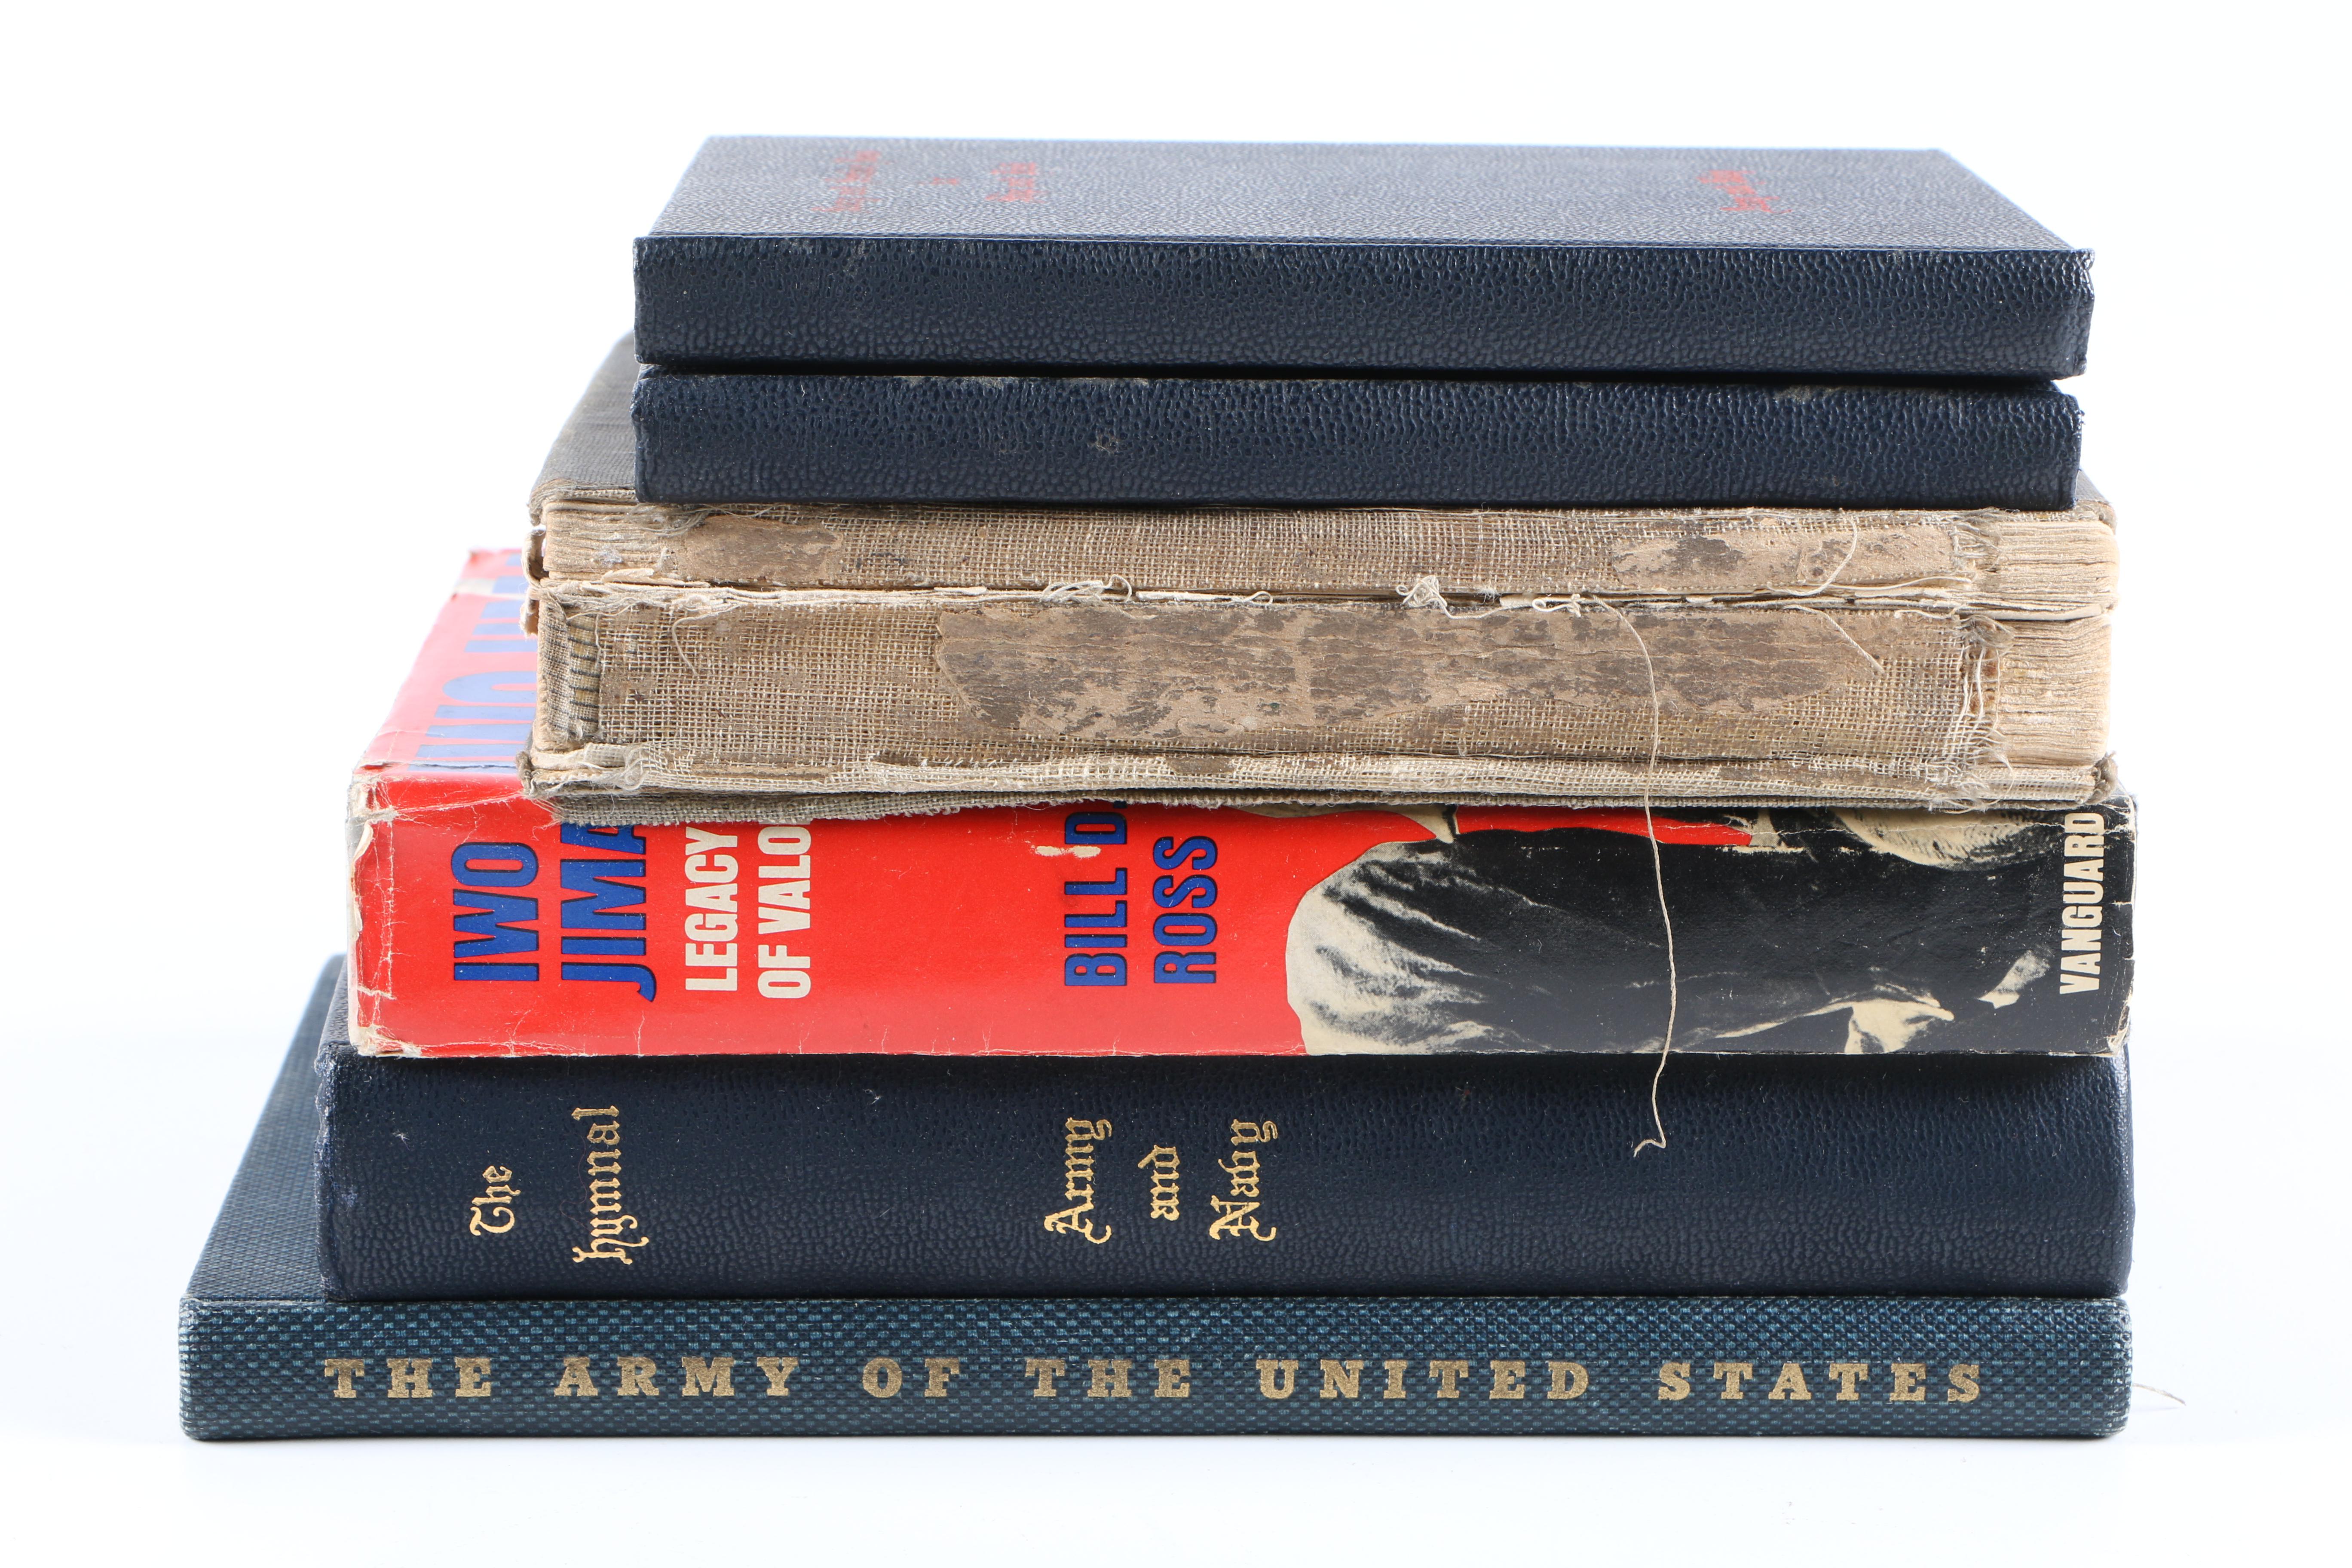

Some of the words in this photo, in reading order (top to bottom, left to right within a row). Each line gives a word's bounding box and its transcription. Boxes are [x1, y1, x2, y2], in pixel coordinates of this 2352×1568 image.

[451, 842, 539, 981] IWO
[560, 822, 656, 1002] JIMA
[685, 826, 738, 992] LEGACY
[757, 819, 812, 934] VALO
[1064, 867, 1127, 986] BILL
[1152, 835, 1218, 983] ROSS
[2059, 812, 2105, 995] VANGUARD
[757, 944, 811, 999] OF
[469, 1165, 521, 1236] The
[1044, 1117, 1112, 1244] Army
[1137, 1144, 1181, 1221] and
[1209, 1118, 1278, 1242] Navy
[325, 1357, 491, 1398] THE
[554, 1357, 798, 1397] ARMY
[862, 1357, 961, 1398] OF
[1025, 1359, 1190, 1398] THE
[1256, 1359, 1589, 1400] UNITED
[1658, 1362, 1980, 1402] STATES
